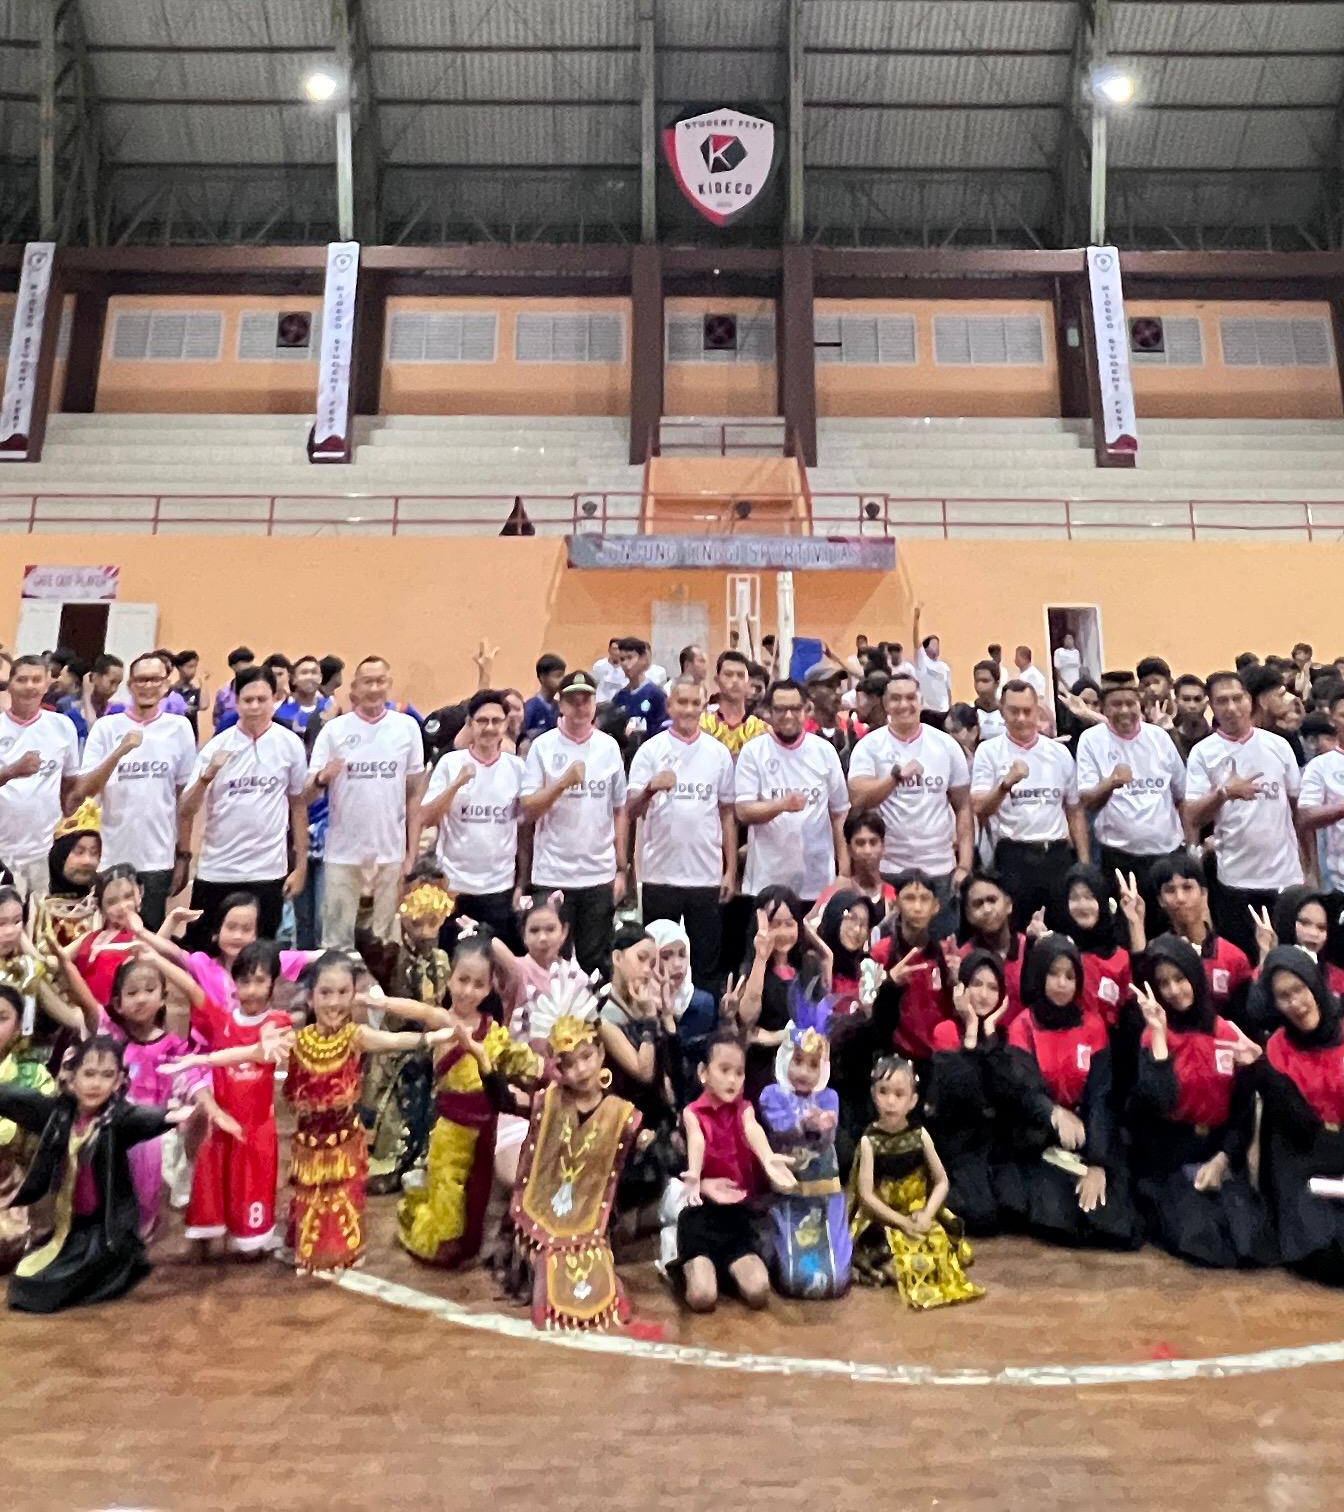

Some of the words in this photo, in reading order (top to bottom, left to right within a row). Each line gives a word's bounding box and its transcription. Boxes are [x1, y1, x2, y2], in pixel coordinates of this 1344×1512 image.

[685, 119, 734, 129] STUDENT
[738, 120, 765, 129] FEST
[698, 182, 753, 195] KIDECO
[117, 760, 170, 774] KIDECO
[346, 762, 398, 775] KIDECO
[228, 775, 280, 789] KIDECO
[1010, 787, 1061, 800] KIDECO
[248, 1201, 263, 1228] 8
